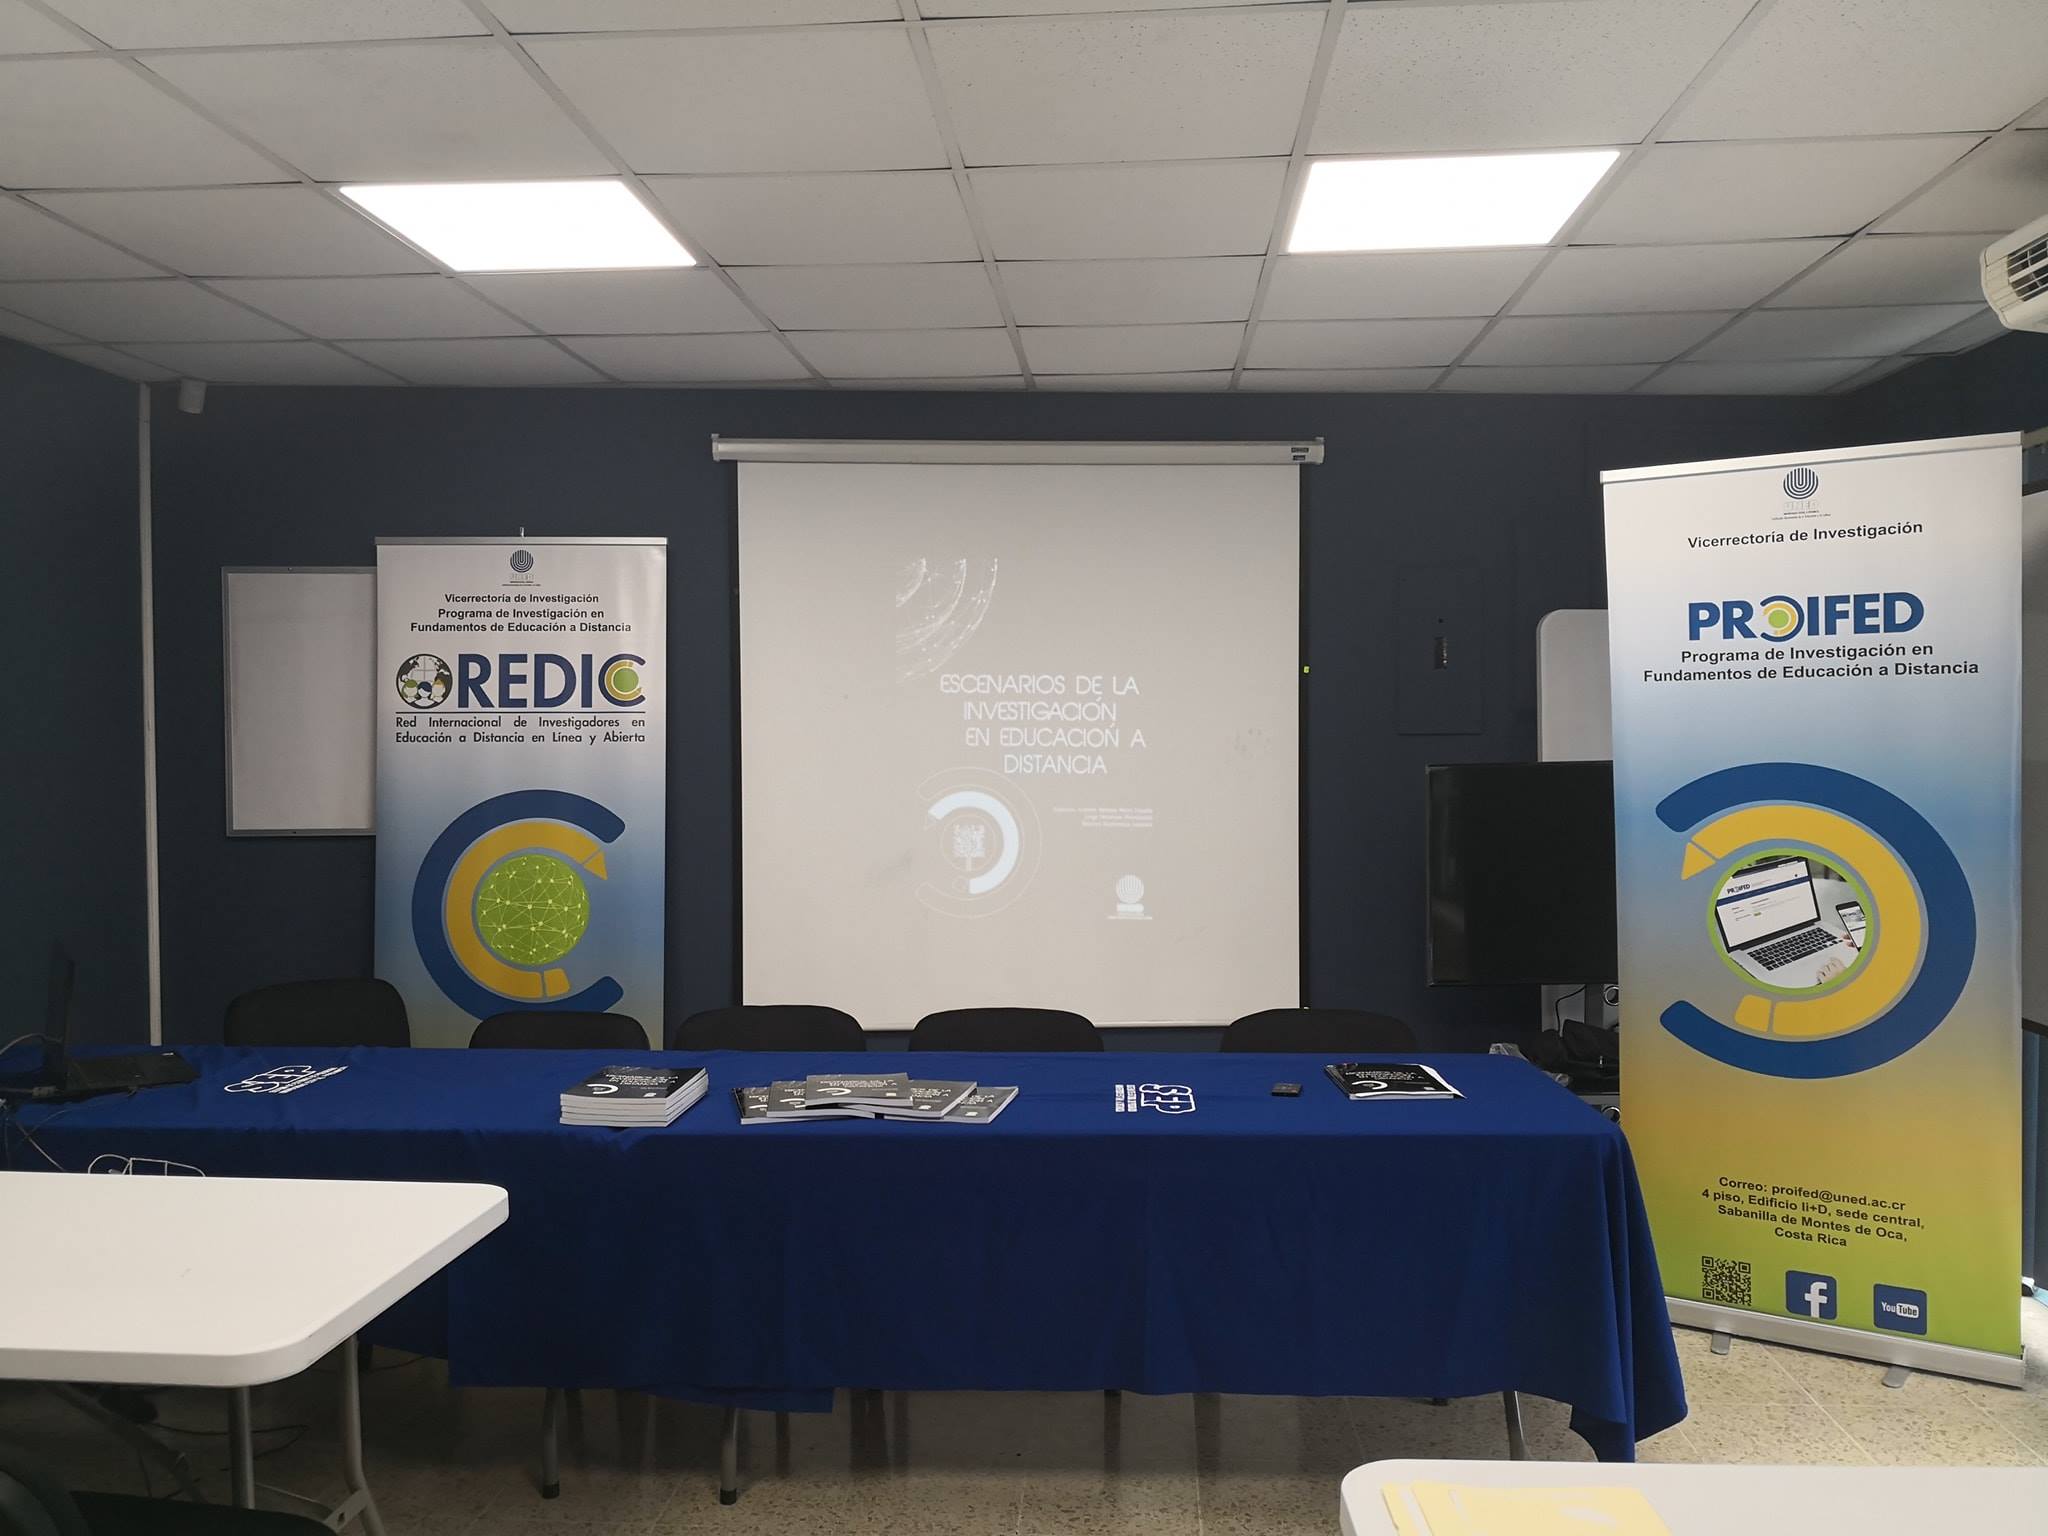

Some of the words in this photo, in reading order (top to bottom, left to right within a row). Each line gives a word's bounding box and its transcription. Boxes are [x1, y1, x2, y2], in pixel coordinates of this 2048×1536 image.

[1688, 531, 1784, 549] Vicerrectoría
[1789, 529, 1808, 541] de
[1814, 521, 1923, 540] Investigación
[444, 593, 511, 603] Vicerrectoría
[514, 593, 526, 603] de
[530, 592, 599, 605] Investigación
[438, 608, 492, 620] Programa
[496, 608, 509, 618] de
[513, 606, 588, 620] Investigación
[591, 610, 604, 618] en
[1688, 591, 1925, 643] PROIFED
[410, 622, 487, 632] Fundamentos
[490, 622, 504, 632] de
[508, 620, 566, 632] Educación
[570, 624, 577, 632] a
[580, 621, 632, 632] Distancia
[1681, 651, 1759, 664] Programa
[1765, 648, 1784, 660] de
[1790, 643, 1906, 660] Investigación
[1912, 645, 1933, 655] en
[1644, 668, 1752, 682] Fundamentos
[1758, 667, 1777, 679] de
[1783, 664, 1873, 679] Educación
[1879, 666, 1889, 676] a
[1895, 661, 1979, 675] Distancia
[940, 674, 1066, 695] ESCENARIOS
[1076, 675, 1102, 695] DE
[1112, 676, 1140, 695] LA
[964, 695, 1116, 721] INVESTIGACIÓN
[396, 716, 416, 728] Red
[429, 716, 501, 728] Internacional
[513, 716, 527, 728] de
[539, 716, 620, 730] Investigadores
[632, 719, 645, 727] en
[396, 731, 452, 743] Educación
[459, 734, 466, 743] a
[473, 732, 524, 743] Distancia
[532, 734, 545, 743] en
[552, 731, 582, 743] Línea
[589, 734, 597, 746] y
[603, 732, 645, 743] Abierta
[965, 728, 990, 746] EN
[1000, 723, 1119, 748] EDUCACIÓN
[1130, 729, 1147, 748] A
[1004, 754, 1107, 774] DISTANCIA
[1719, 1176, 1768, 1193] Correo:
[1772, 1185, 1906, 1211] proifed@uned.ac.cr
[1702, 1188, 1709, 1199] 4
[1713, 1191, 1744, 1204] piso,
[1748, 1195, 1798, 1210] Edificio
[1836, 1209, 1868, 1220] sede
[1873, 1215, 1924, 1230] central,
[1718, 1204, 1777, 1222] Sabanilla
[1781, 1214, 1797, 1225] de
[1801, 1217, 1851, 1232] Montes
[1855, 1225, 1871, 1236] de
[1876, 1227, 1907, 1242] Oca,
[1774, 1226, 1813, 1242] Costa
[1817, 1233, 1847, 1247] Rica
[1881, 1301, 1919, 1319] YouTube
